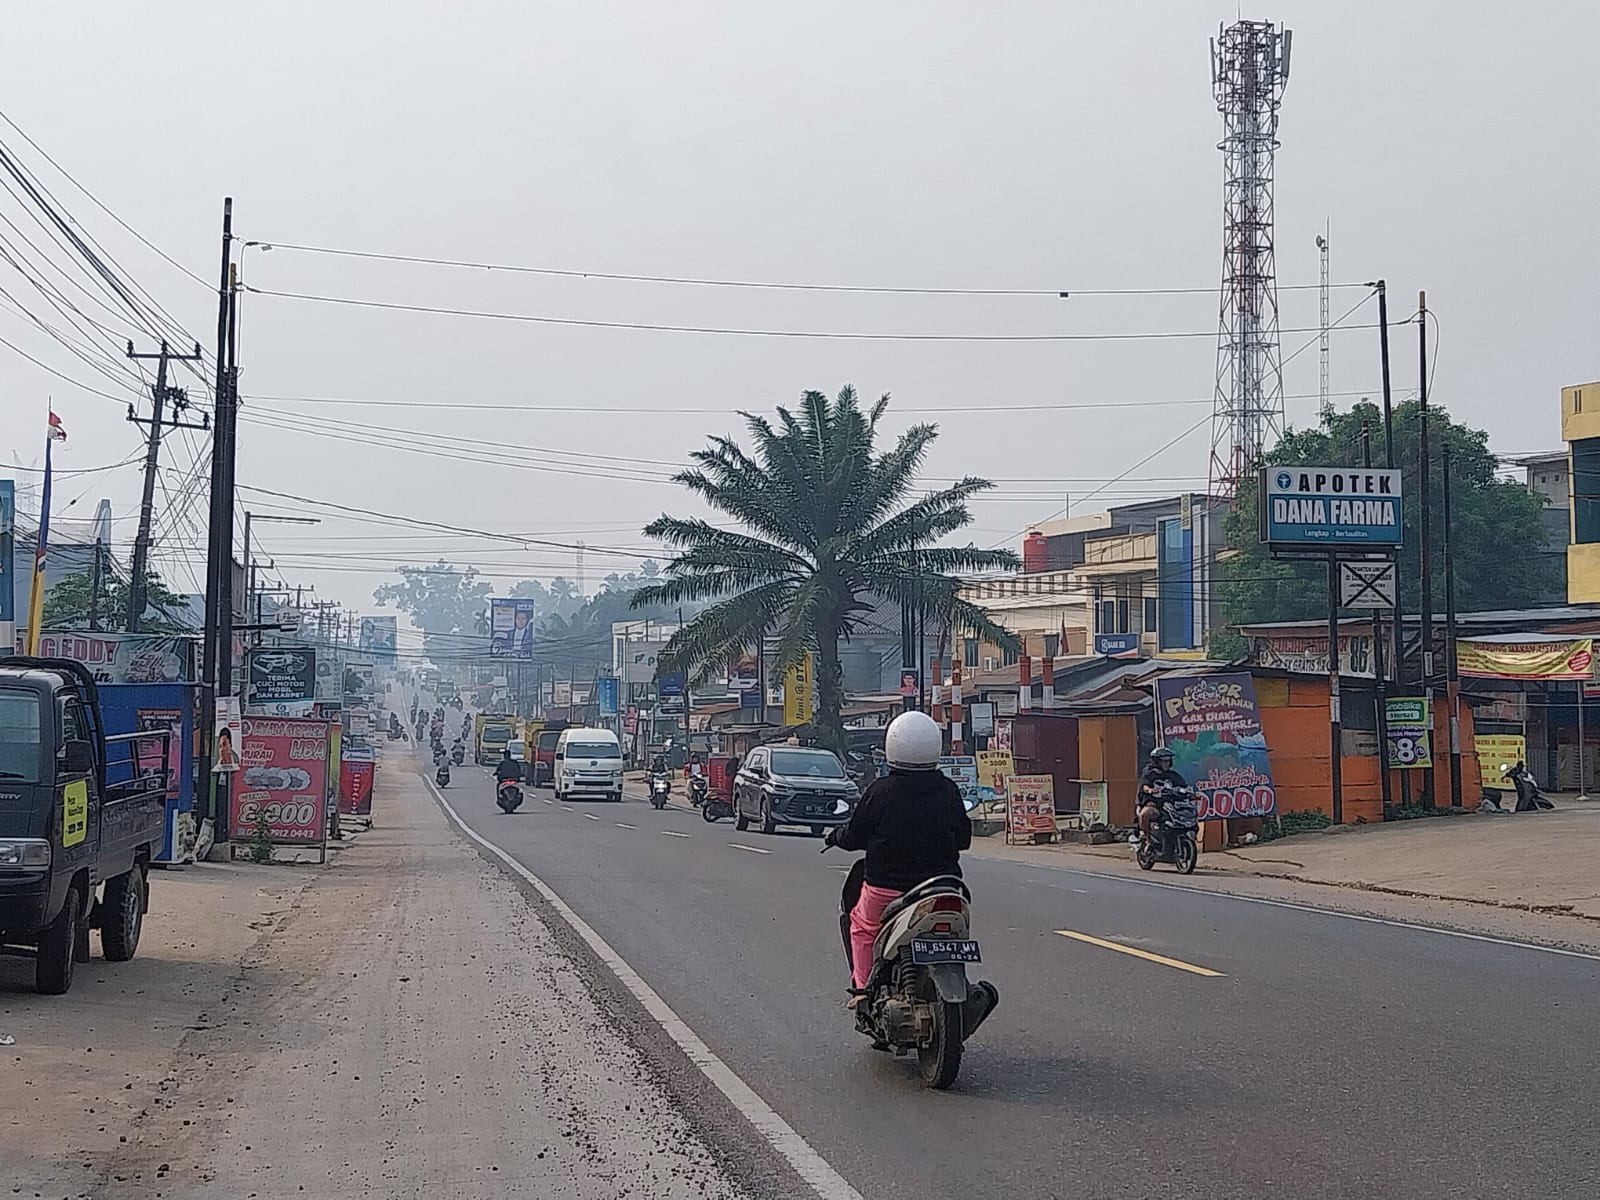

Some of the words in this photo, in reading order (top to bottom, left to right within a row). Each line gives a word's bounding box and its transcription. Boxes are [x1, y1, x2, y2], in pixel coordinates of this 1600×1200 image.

[1298, 474, 1391, 494] APOTEK
[1274, 499, 1327, 524] DANA
[1330, 500, 1395, 526] FARMA
[1304, 529, 1330, 538] Lengkap
[253, 721, 285, 736] AYAM
[290, 739, 326, 760] HBA
[914, 942, 927, 952] BH
[933, 942, 957, 952] 6547
